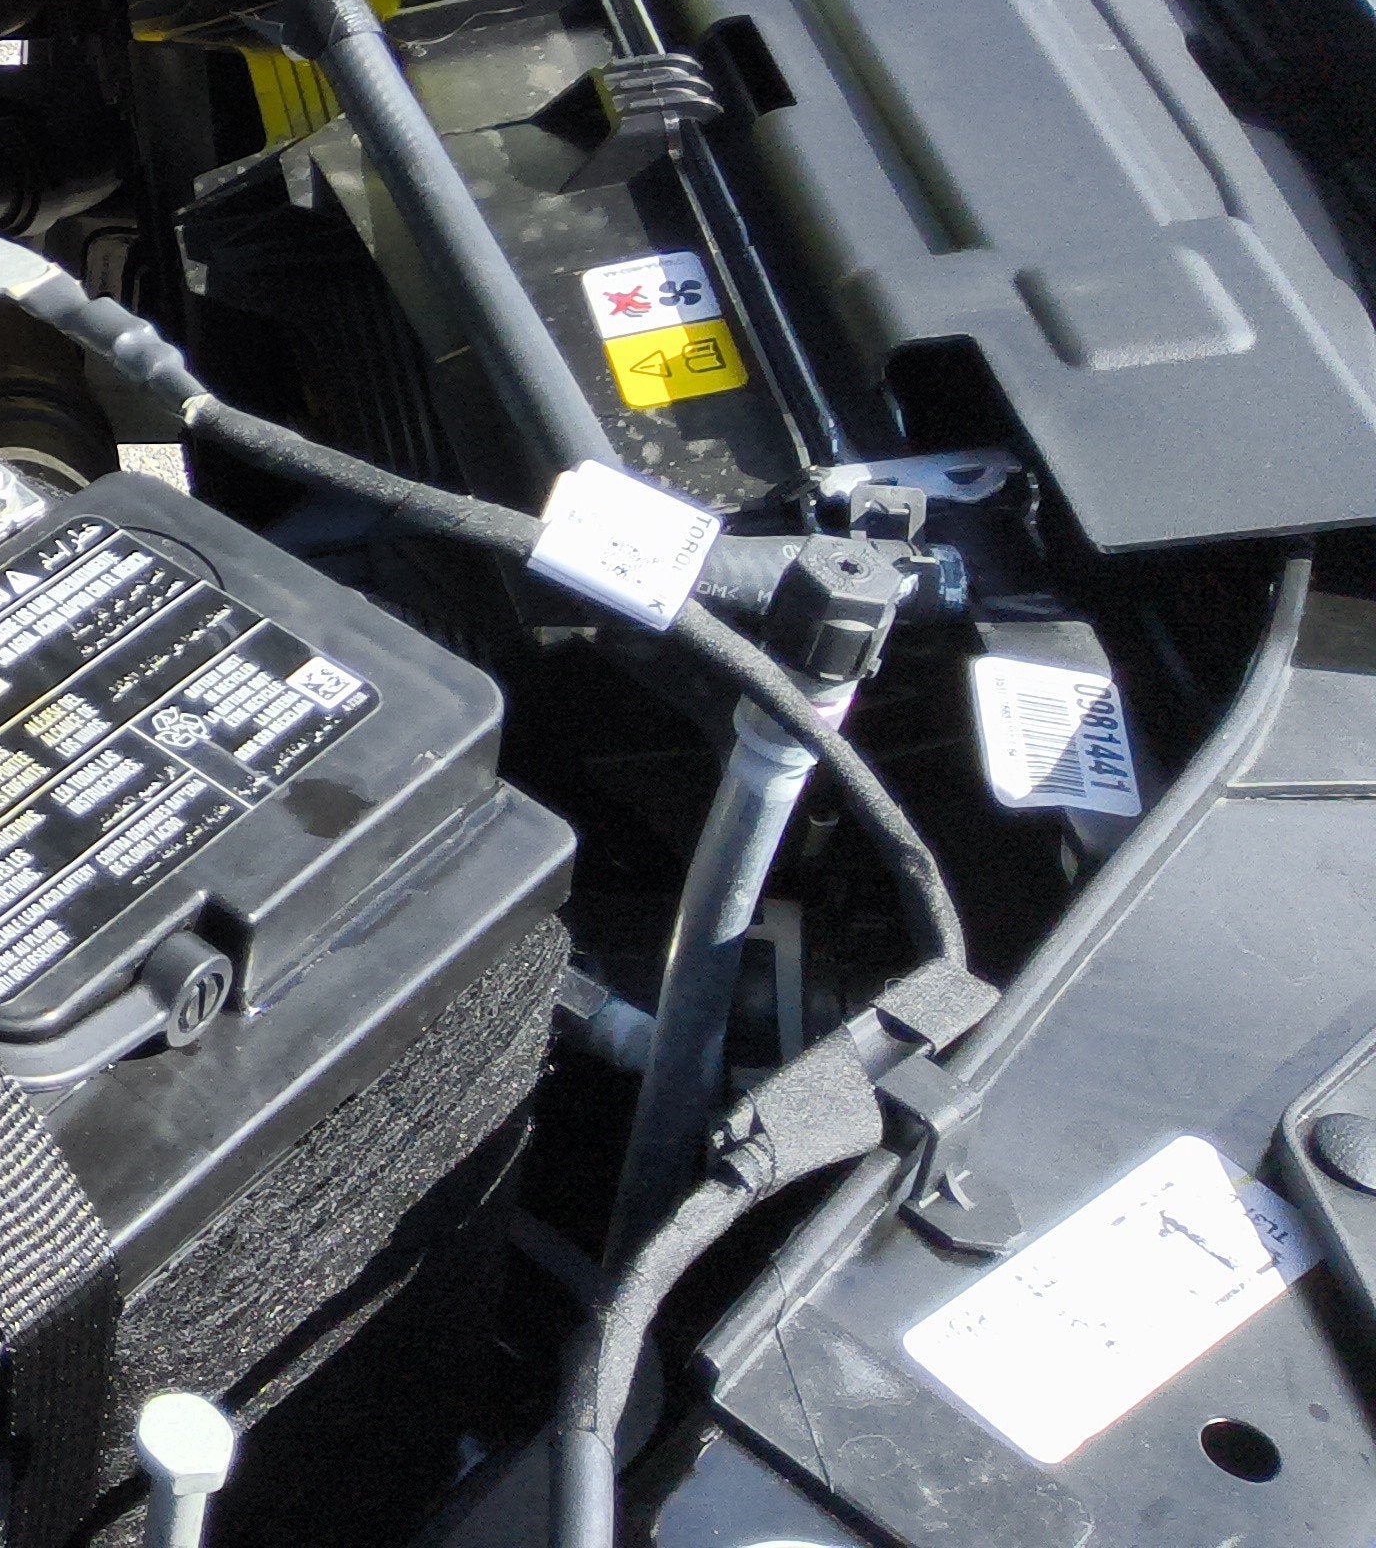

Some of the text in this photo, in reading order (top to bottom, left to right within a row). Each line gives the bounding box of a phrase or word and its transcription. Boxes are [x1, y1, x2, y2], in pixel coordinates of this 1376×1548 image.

[1074, 684, 1130, 792] 0981441
[48, 748, 122, 803] LEA TODAS LAS
[3, 845, 34, 868] LES
[10, 940, 32, 956] AU
